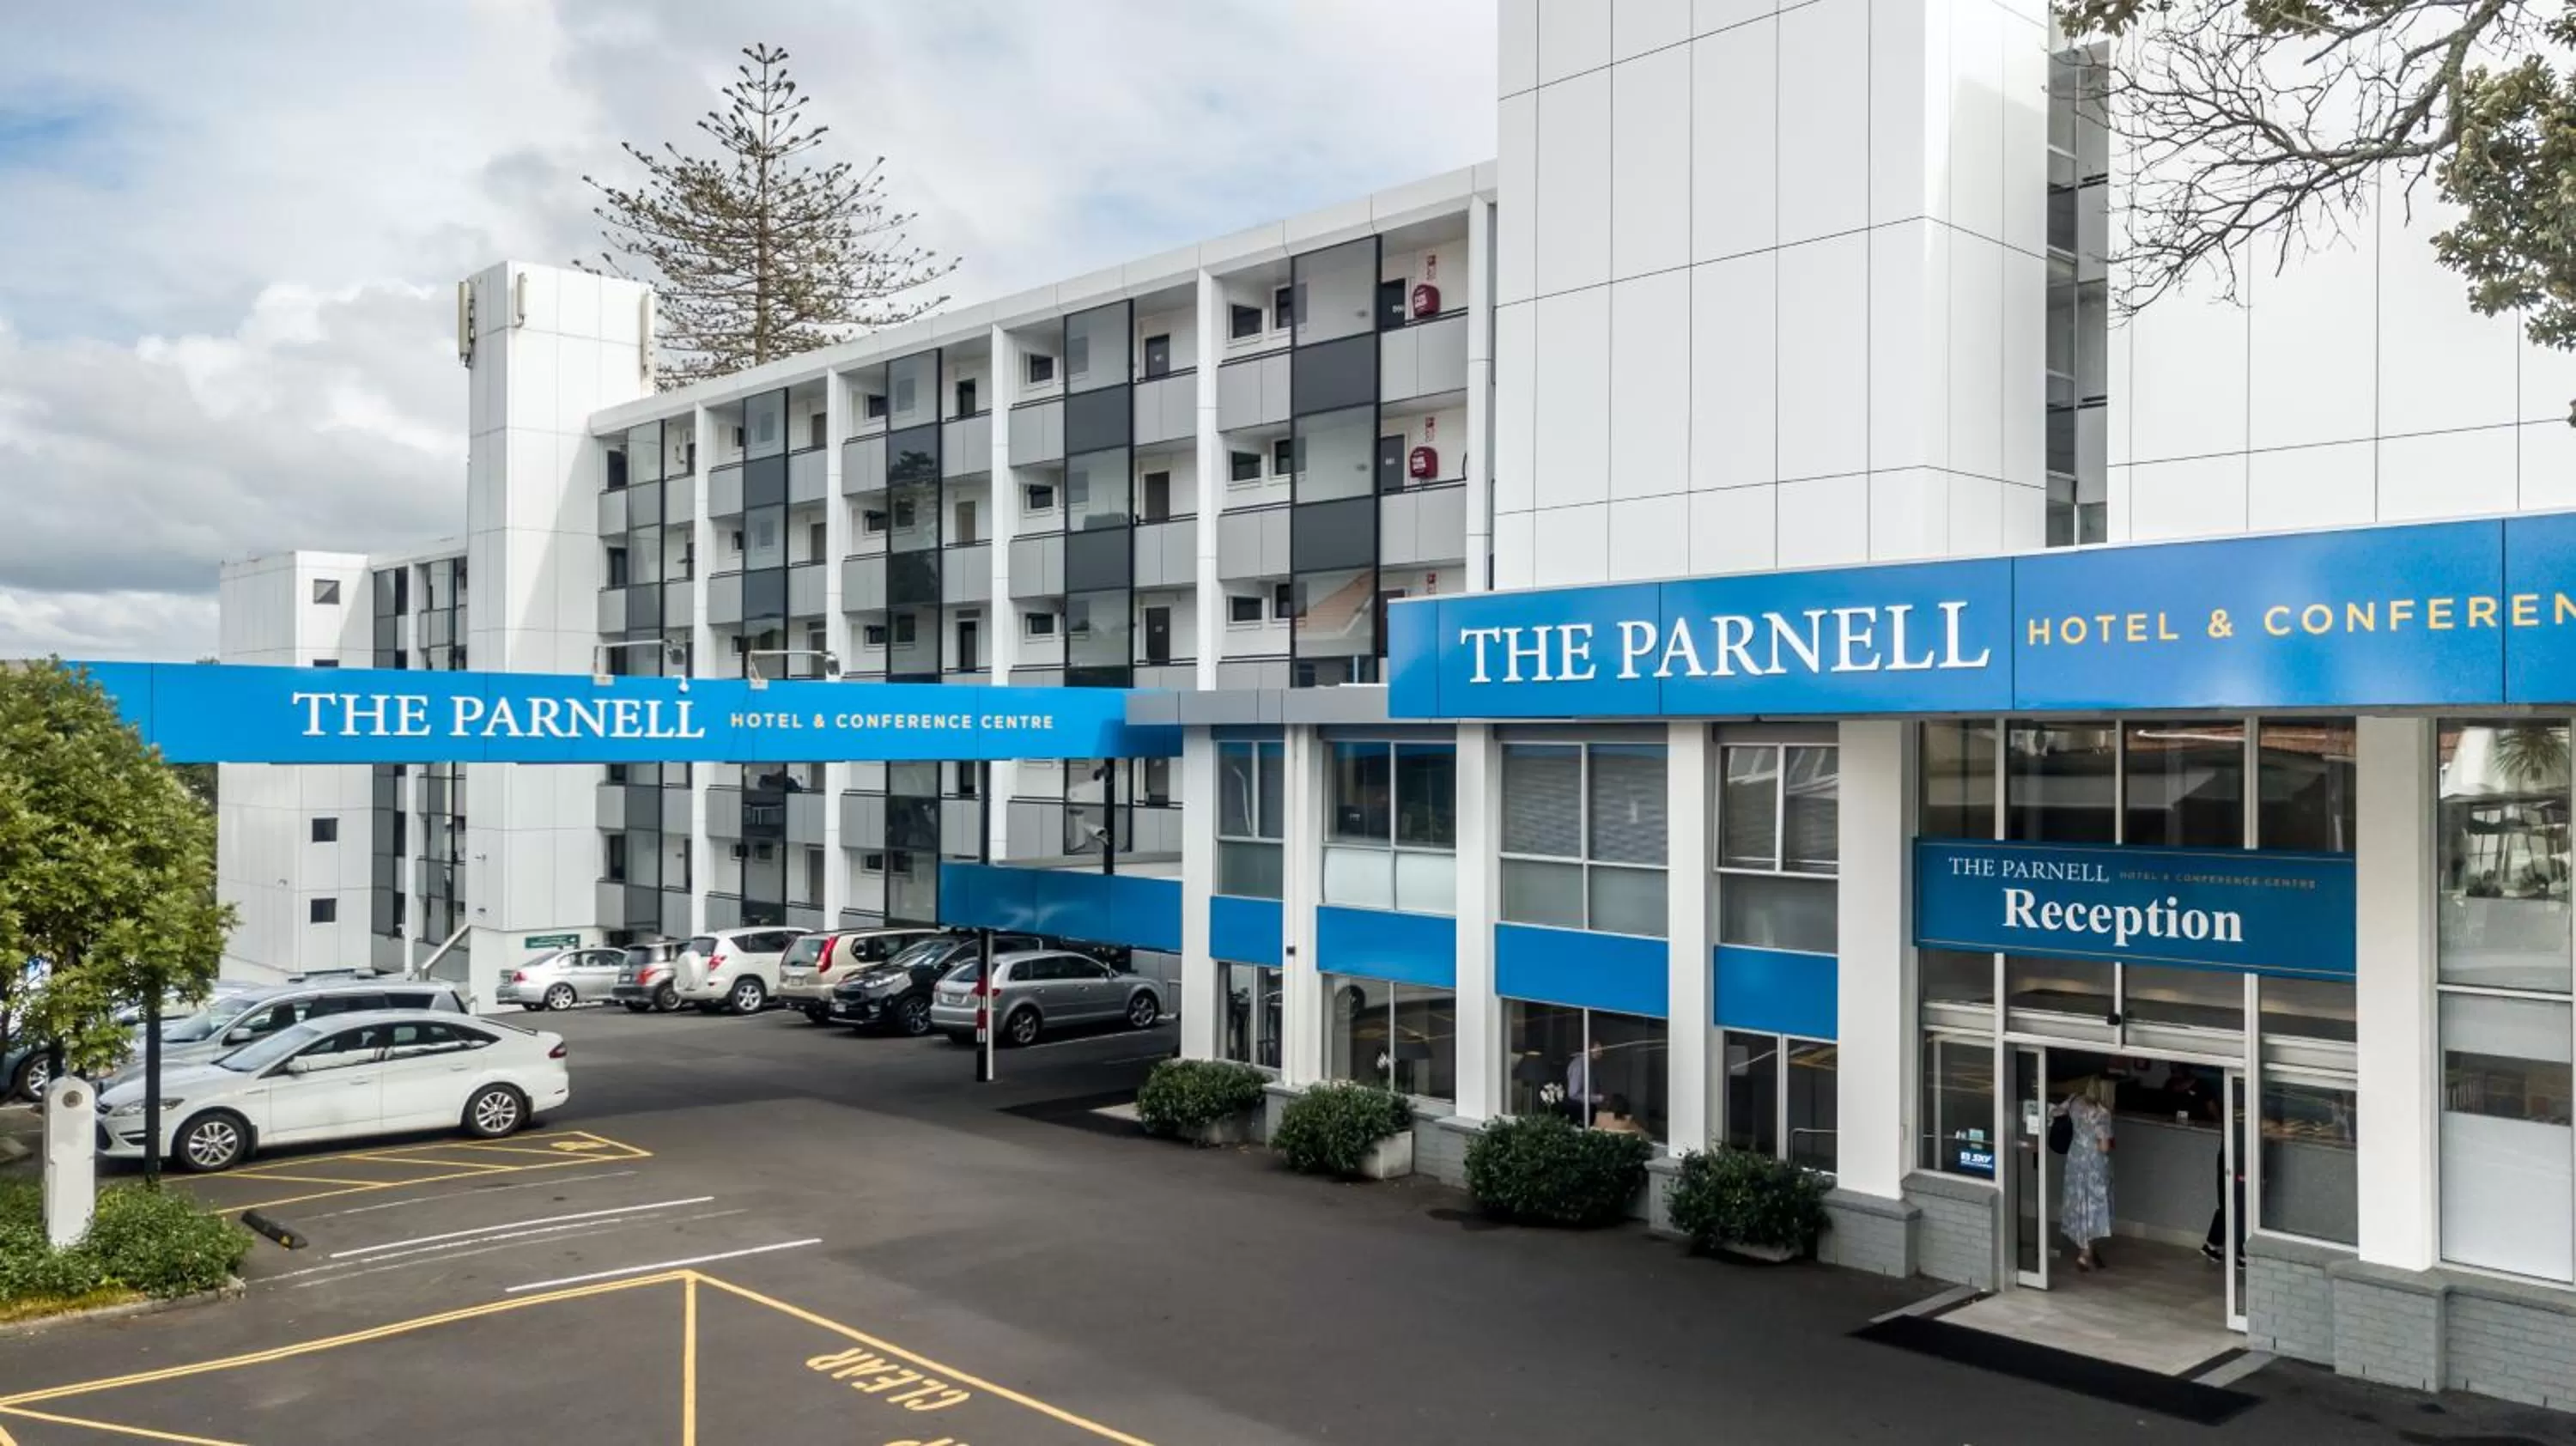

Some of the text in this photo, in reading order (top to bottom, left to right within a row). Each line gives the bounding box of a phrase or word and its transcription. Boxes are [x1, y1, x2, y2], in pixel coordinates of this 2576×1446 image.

[1461, 592, 2576, 684] THE PARNELL HOTEL & CONFEREN
[292, 691, 1054, 739] THE PARNELL HOTEL & CONFERENCE CENTRE
[1948, 856, 1996, 877] THE
[2002, 860, 2110, 883] PARNELL
[2119, 871, 2158, 881] HOTEL
[2176, 872, 2258, 886] CONFERENCE
[2263, 877, 2317, 890] CENTRE
[2002, 887, 2244, 947] Reception
[805, 1346, 972, 1411] CLEAR
